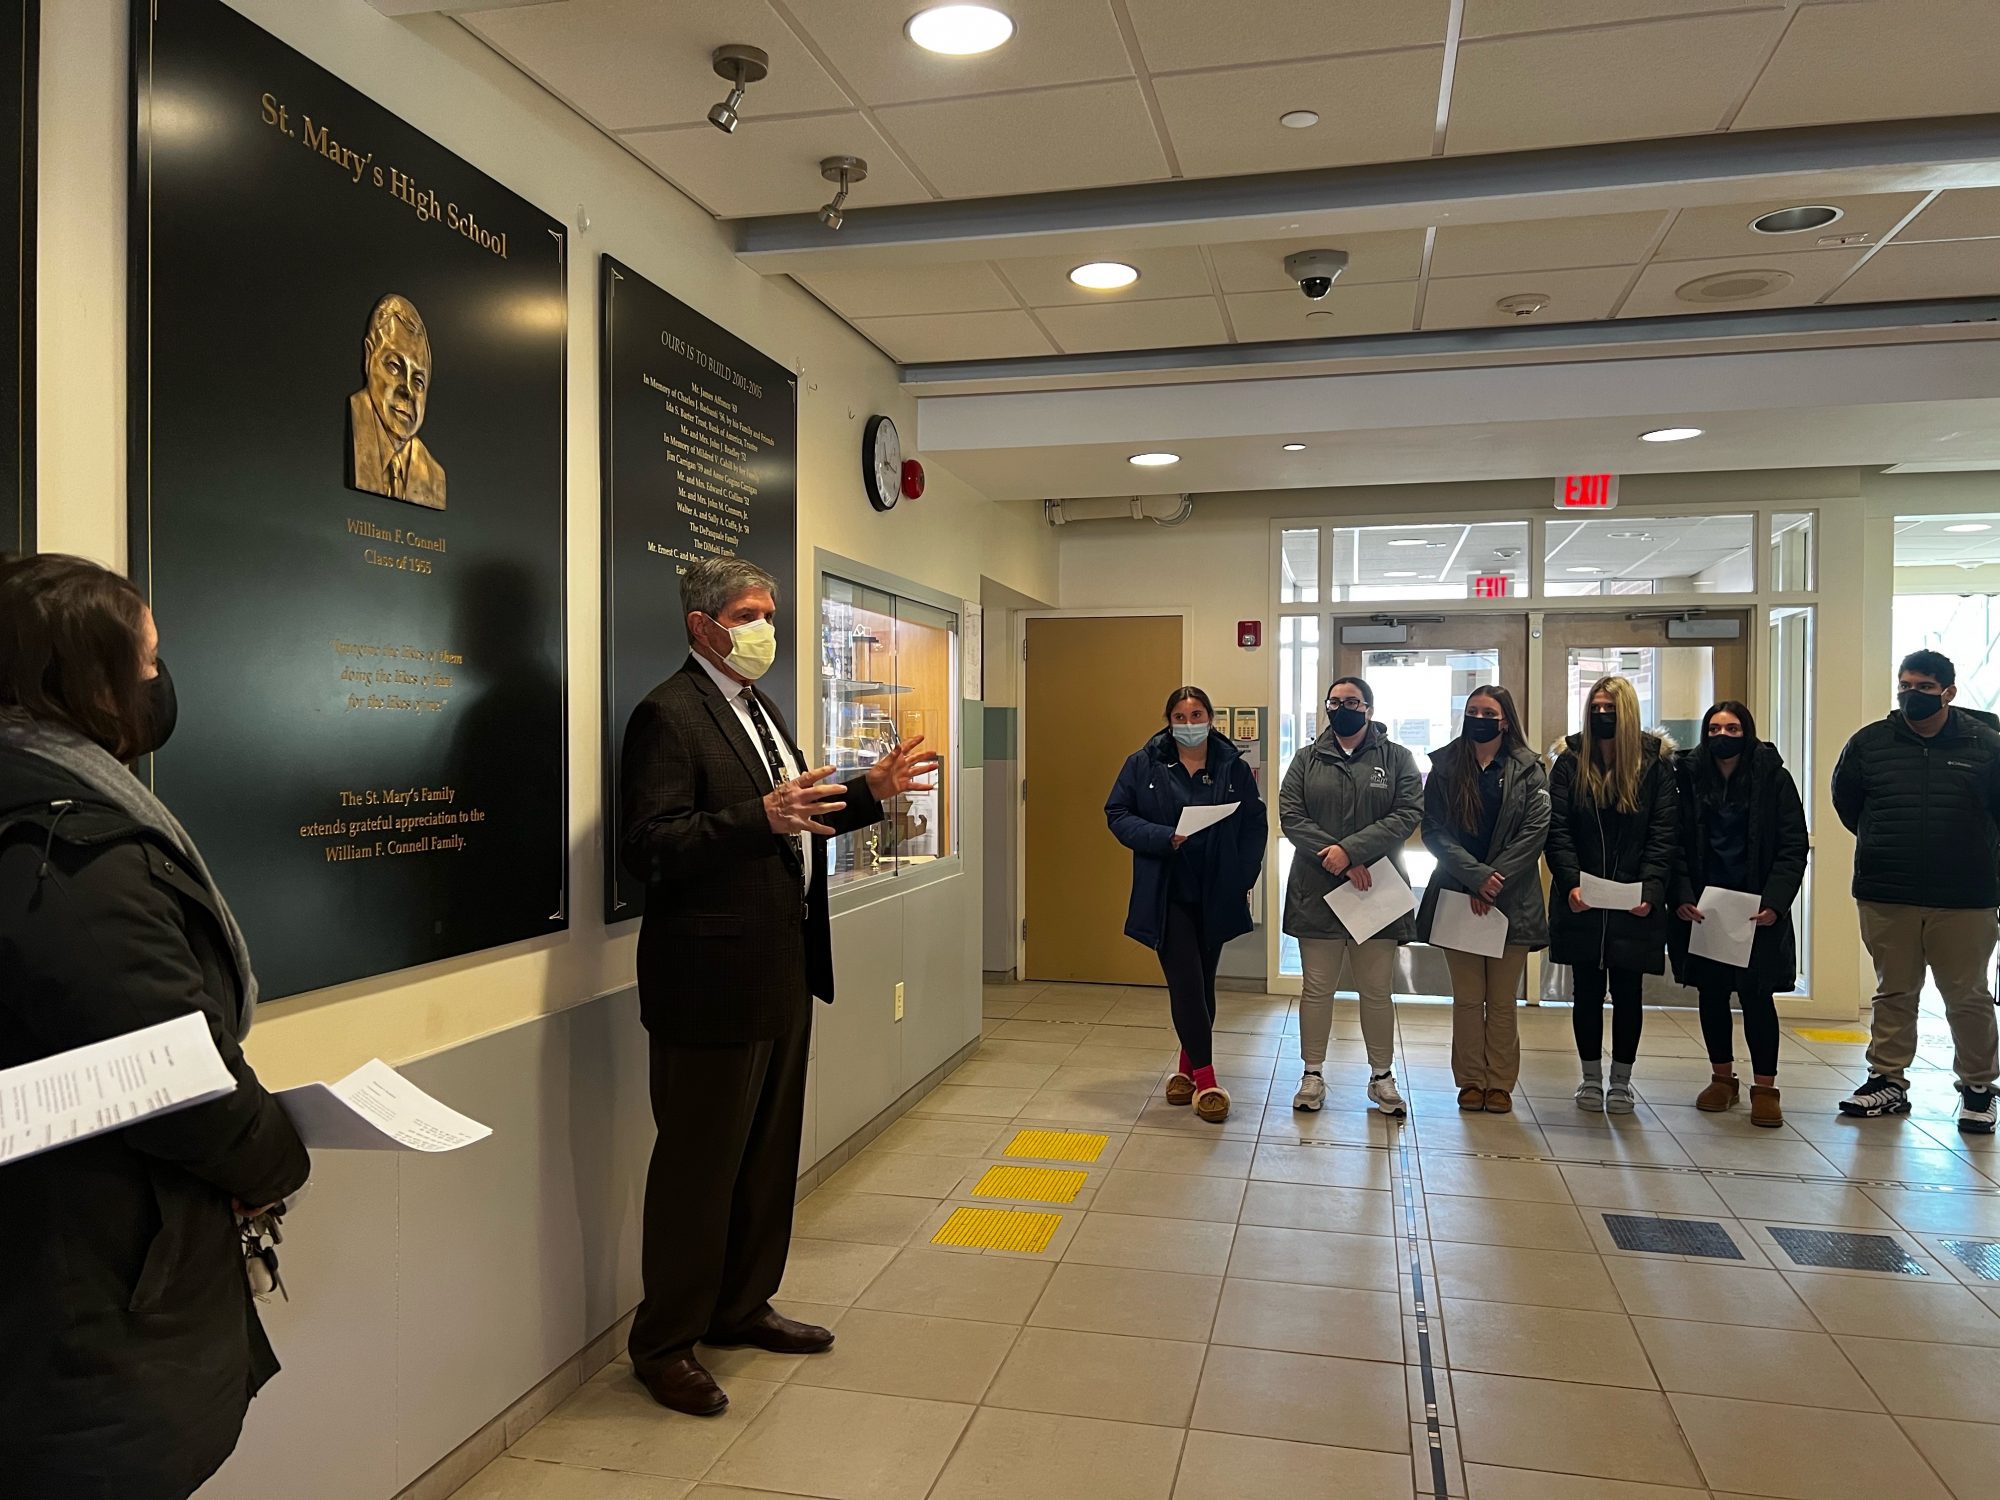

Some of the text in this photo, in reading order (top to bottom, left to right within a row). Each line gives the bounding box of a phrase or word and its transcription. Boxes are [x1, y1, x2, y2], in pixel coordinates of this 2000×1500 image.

[261, 93, 508, 260] St. Mary's High School
[661, 330, 763, 398] OURS IS TO BUILD 2001-2005
[643, 373, 650, 385] In
[650, 376, 671, 397] Memory
[671, 389, 677, 399] of
[677, 391, 695, 407] Charles
[726, 415, 732, 428] by
[739, 421, 753, 437] Family
[753, 431, 761, 440] and
[701, 387, 713, 401] James
[674, 405, 680, 416] S.
[695, 415, 708, 430] Trust,
[708, 421, 720, 435] Bank
[720, 428, 726, 437] of
[726, 431, 744, 447] America,
[681, 423, 690, 436] Mr.
[690, 430, 699, 440] and
[699, 432, 710, 445] Mrs.
[709, 437, 721, 450] John
[663, 432, 670, 444] In
[670, 435, 690, 454] Memory
[690, 445, 696, 455] of
[676, 470, 686, 481] Mr.
[686, 476, 695, 486] and
[695, 477, 706, 489] Mrs.
[706, 481, 722, 496] Edward
[703, 467, 713, 477] and
[678, 486, 687, 498] Mr.
[687, 492, 697, 502] and
[696, 493, 707, 505] Mrs.
[707, 497, 719, 509] John
[1564, 473, 1613, 506] EXIT
[676, 501, 693, 516] Walter
[693, 508, 699, 518] A.
[699, 511, 708, 521] and
[708, 512, 720, 527] Sally
[346, 518, 446, 553] William F. Connell
[689, 521, 699, 533] The
[725, 533, 739, 548] Family
[693, 538, 703, 550] The
[364, 549, 433, 574] Class of 1955
[647, 541, 657, 553] Mr.
[657, 544, 673, 557] Ernest
[673, 548, 679, 558] C.
[680, 551, 689, 561] and
[1476, 576, 1508, 598] EXIT
[439, 649, 463, 664] them
[341, 665, 372, 687] doing
[345, 693, 364, 713] for
[340, 786, 455, 806] The St. Mary's Family
[300, 808, 485, 837] extends grateful appreciation to the
[325, 834, 467, 862] William F. Connell Family.
